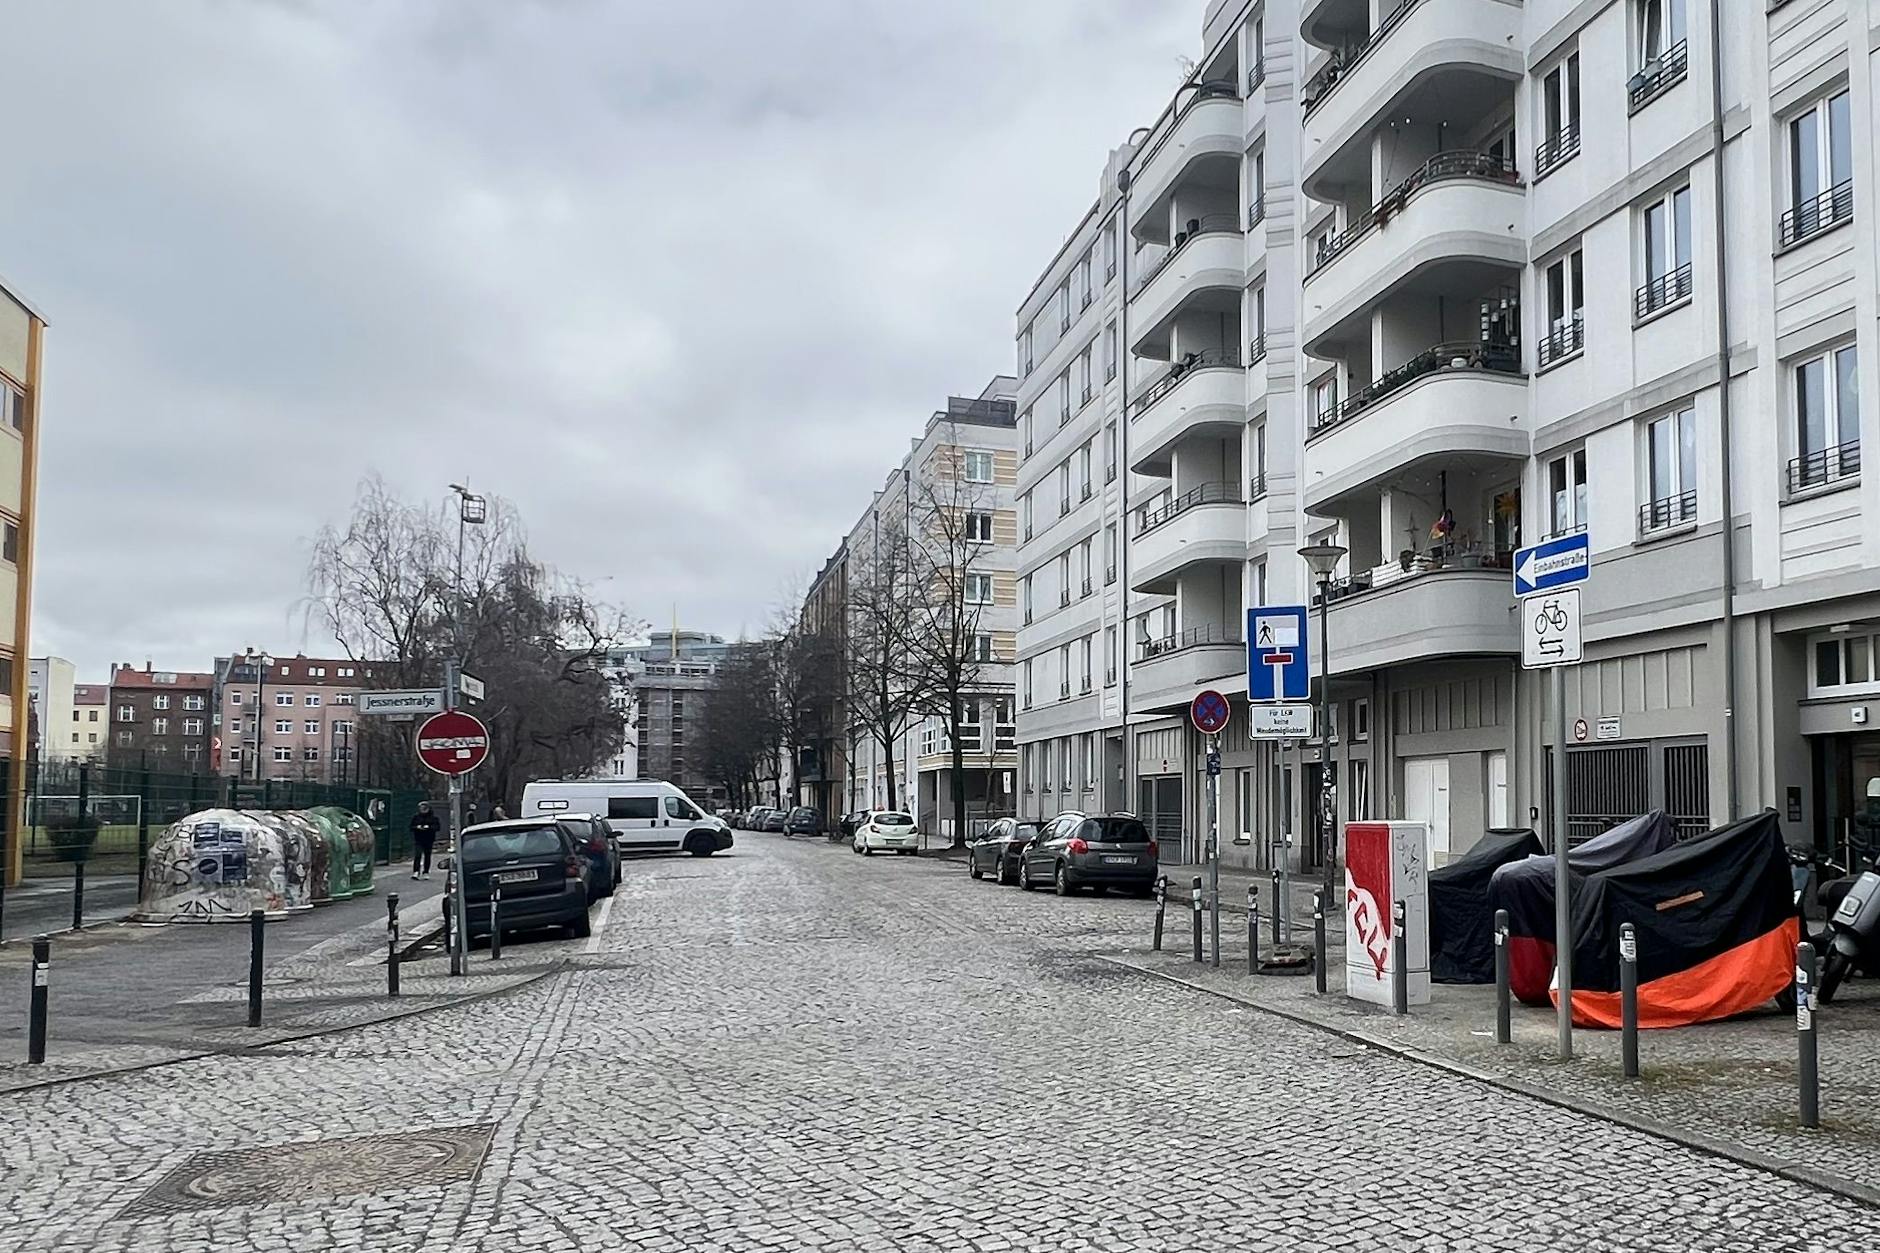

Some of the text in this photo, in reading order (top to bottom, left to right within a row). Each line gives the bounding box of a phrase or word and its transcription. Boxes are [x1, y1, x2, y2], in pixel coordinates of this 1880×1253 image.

[1534, 552, 1584, 574] Einbahnstraße
[366, 695, 435, 709] Jessnerstraße
[1269, 708, 1279, 717] Für
